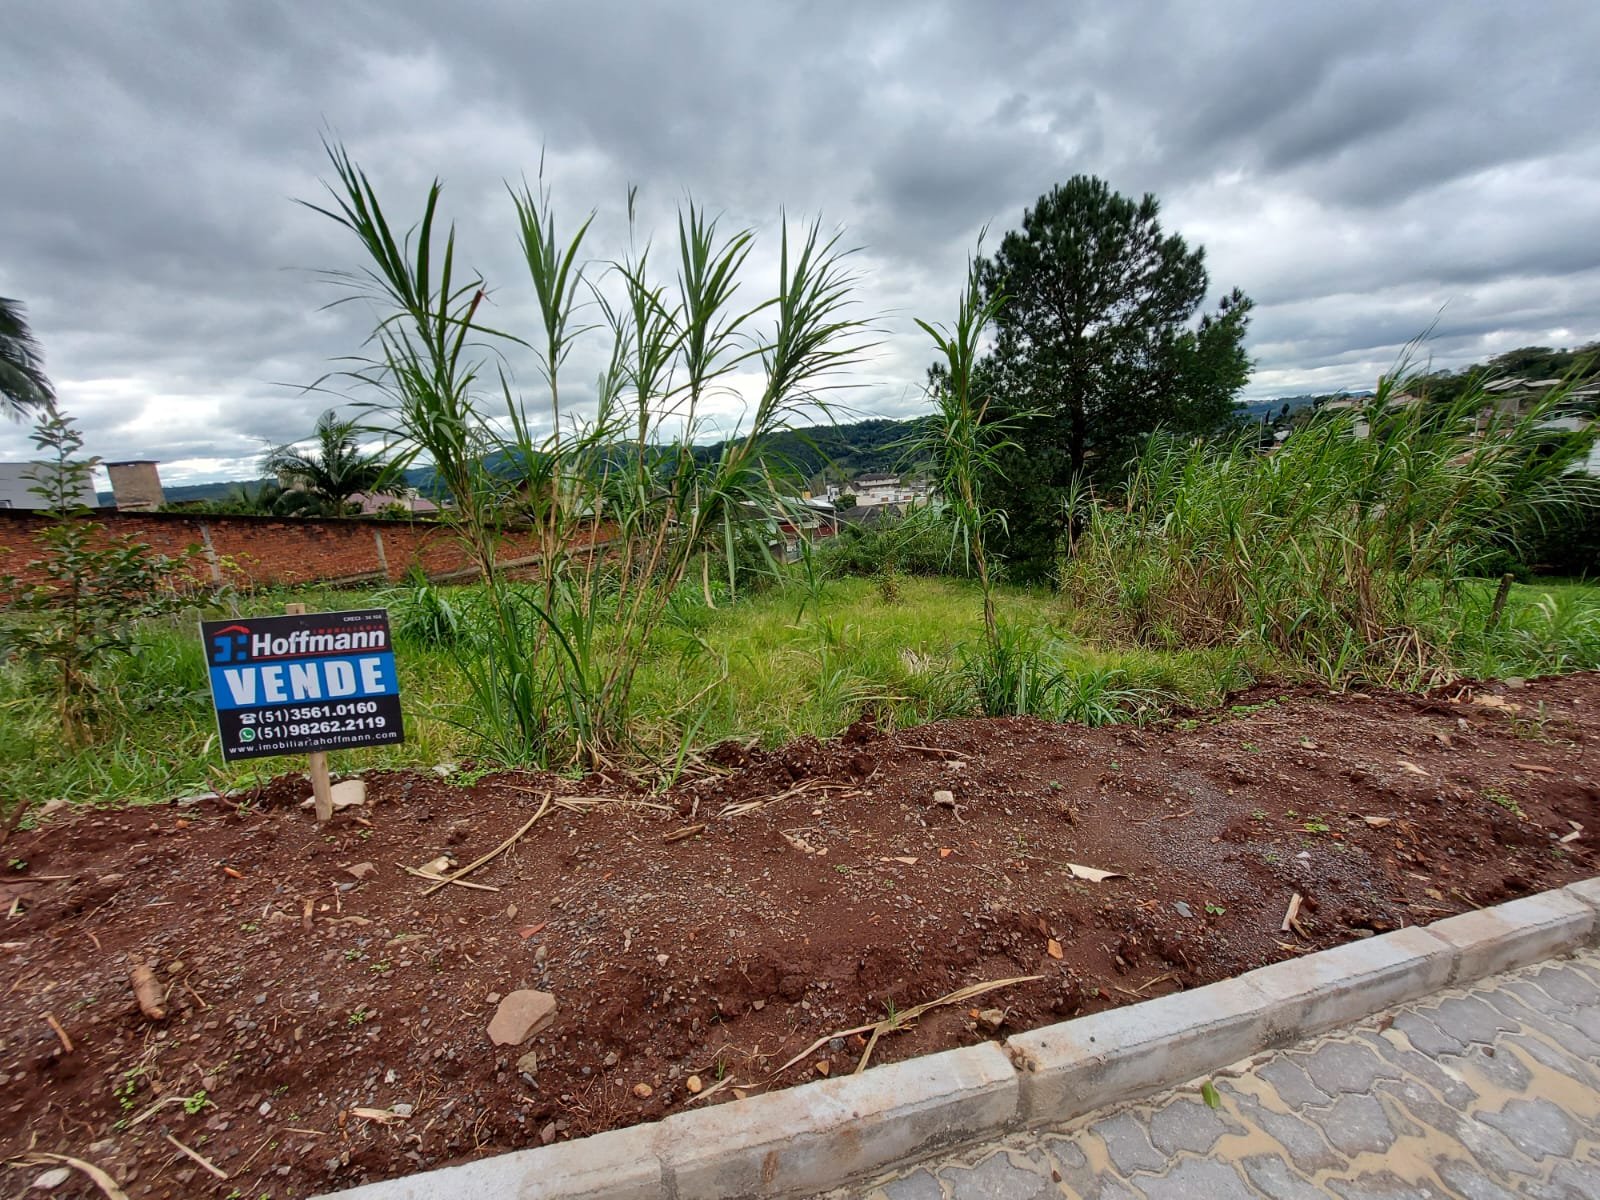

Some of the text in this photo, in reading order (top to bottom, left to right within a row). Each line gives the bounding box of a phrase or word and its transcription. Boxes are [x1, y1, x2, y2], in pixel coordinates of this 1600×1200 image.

[252, 630, 386, 657] Hoffmann
[223, 657, 386, 705] VENDE
[258, 701, 378, 724] (51)3561.0160
[257, 716, 386, 740] (51)98262.2119
